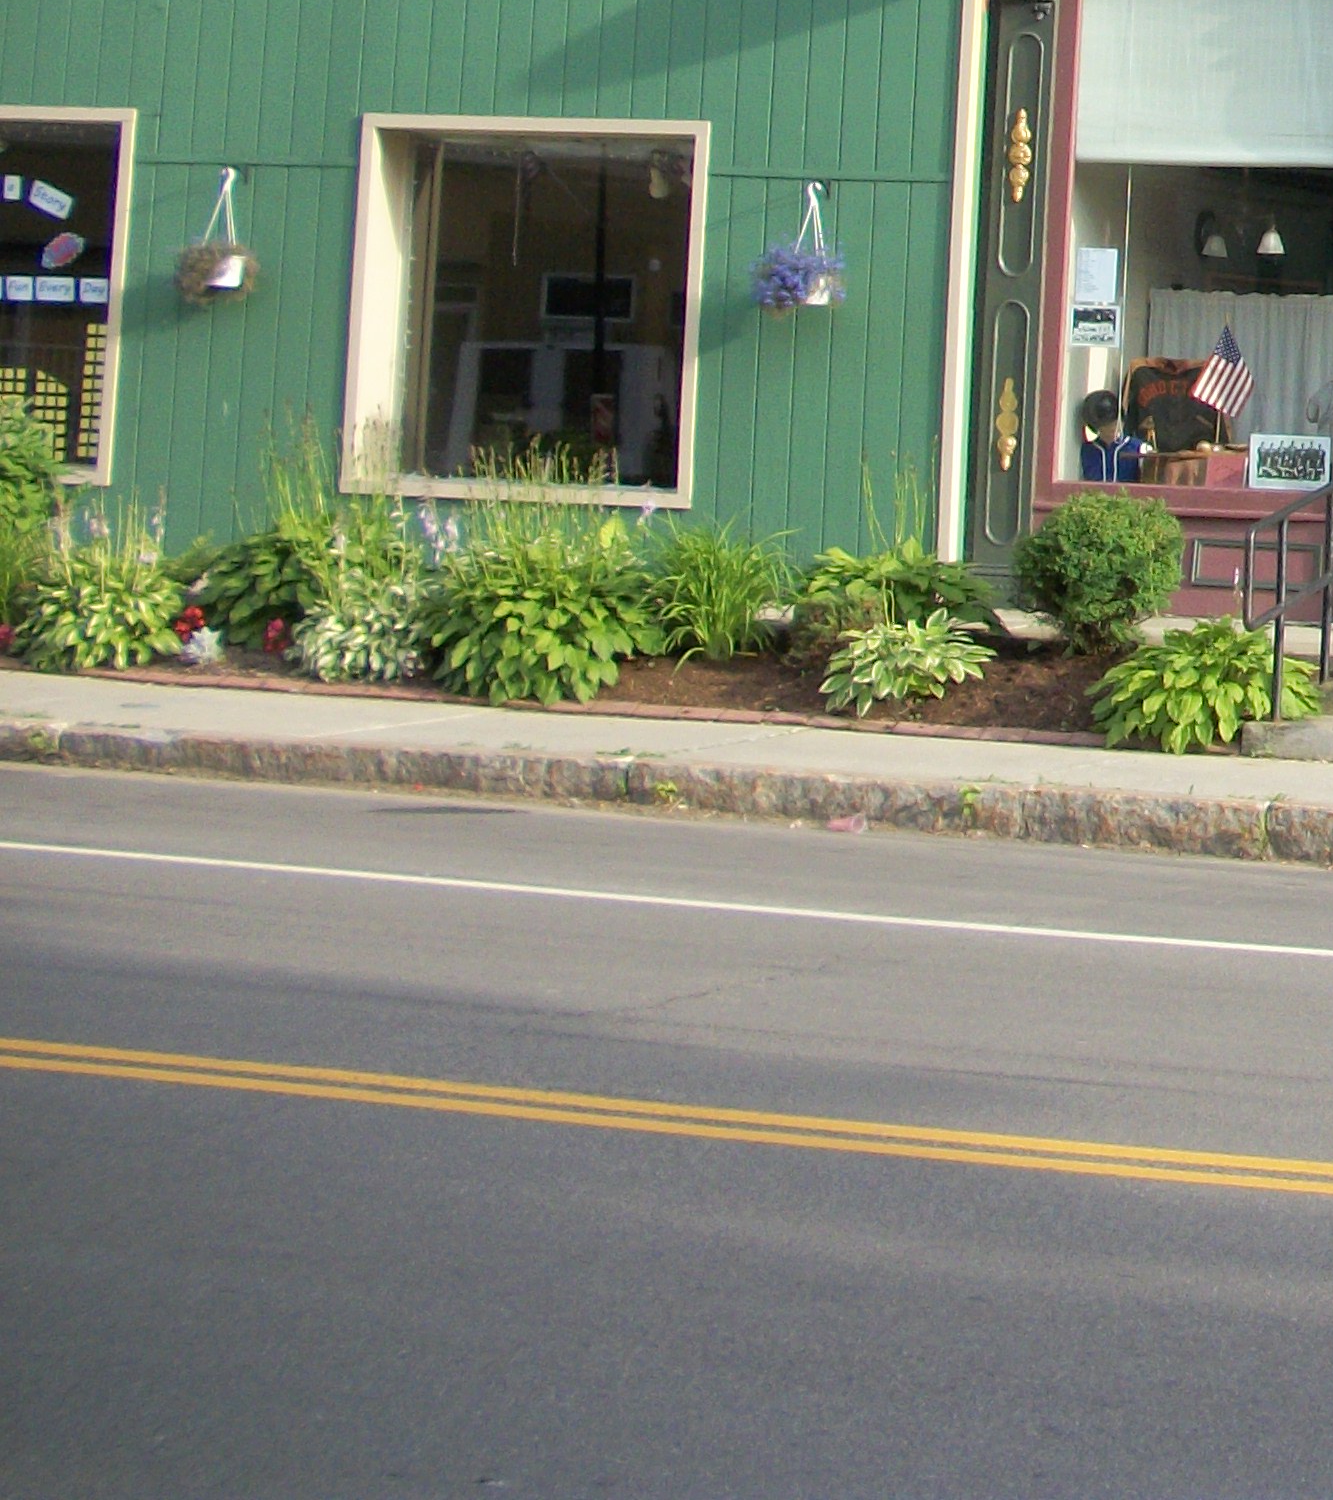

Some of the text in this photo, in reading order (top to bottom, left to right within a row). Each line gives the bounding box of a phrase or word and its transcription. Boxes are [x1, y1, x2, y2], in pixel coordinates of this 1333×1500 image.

[34, 186, 66, 211] Story
[40, 282, 71, 295] Every
[84, 282, 106, 293] Day
